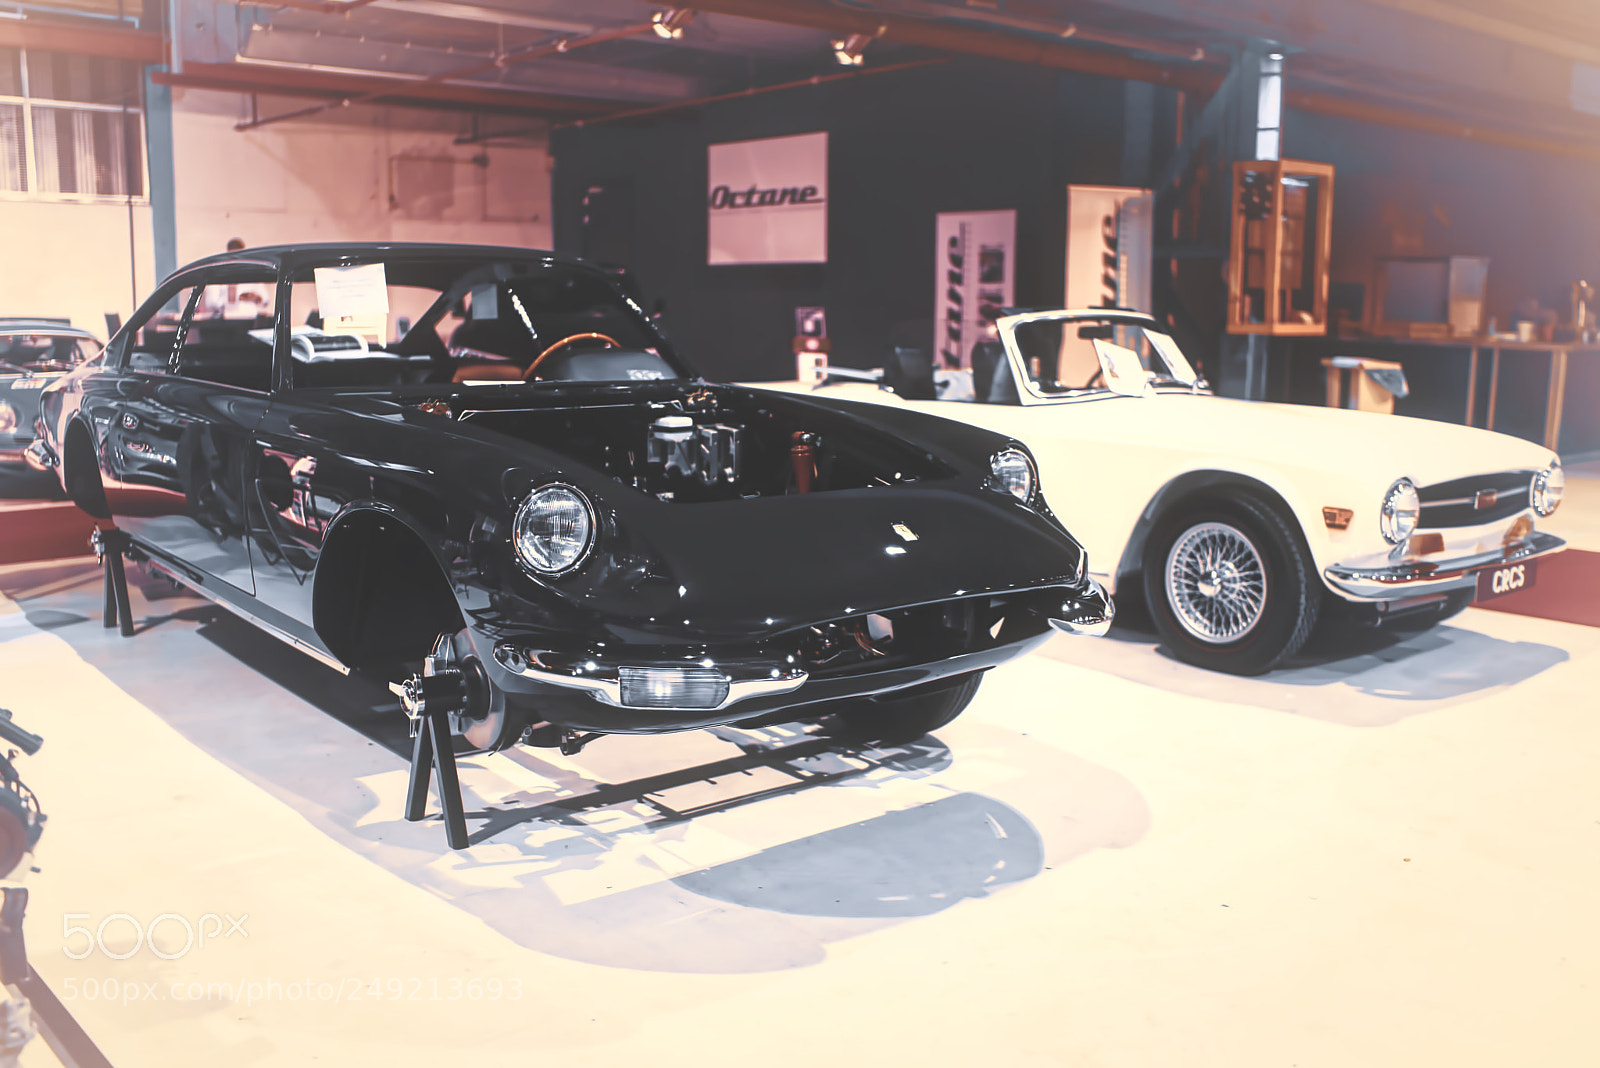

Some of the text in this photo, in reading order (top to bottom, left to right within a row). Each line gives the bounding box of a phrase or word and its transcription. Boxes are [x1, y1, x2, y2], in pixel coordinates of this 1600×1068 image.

[711, 183, 824, 209] Octane
[941, 222, 966, 369] tane
[1492, 564, 1526, 593] CRCS
